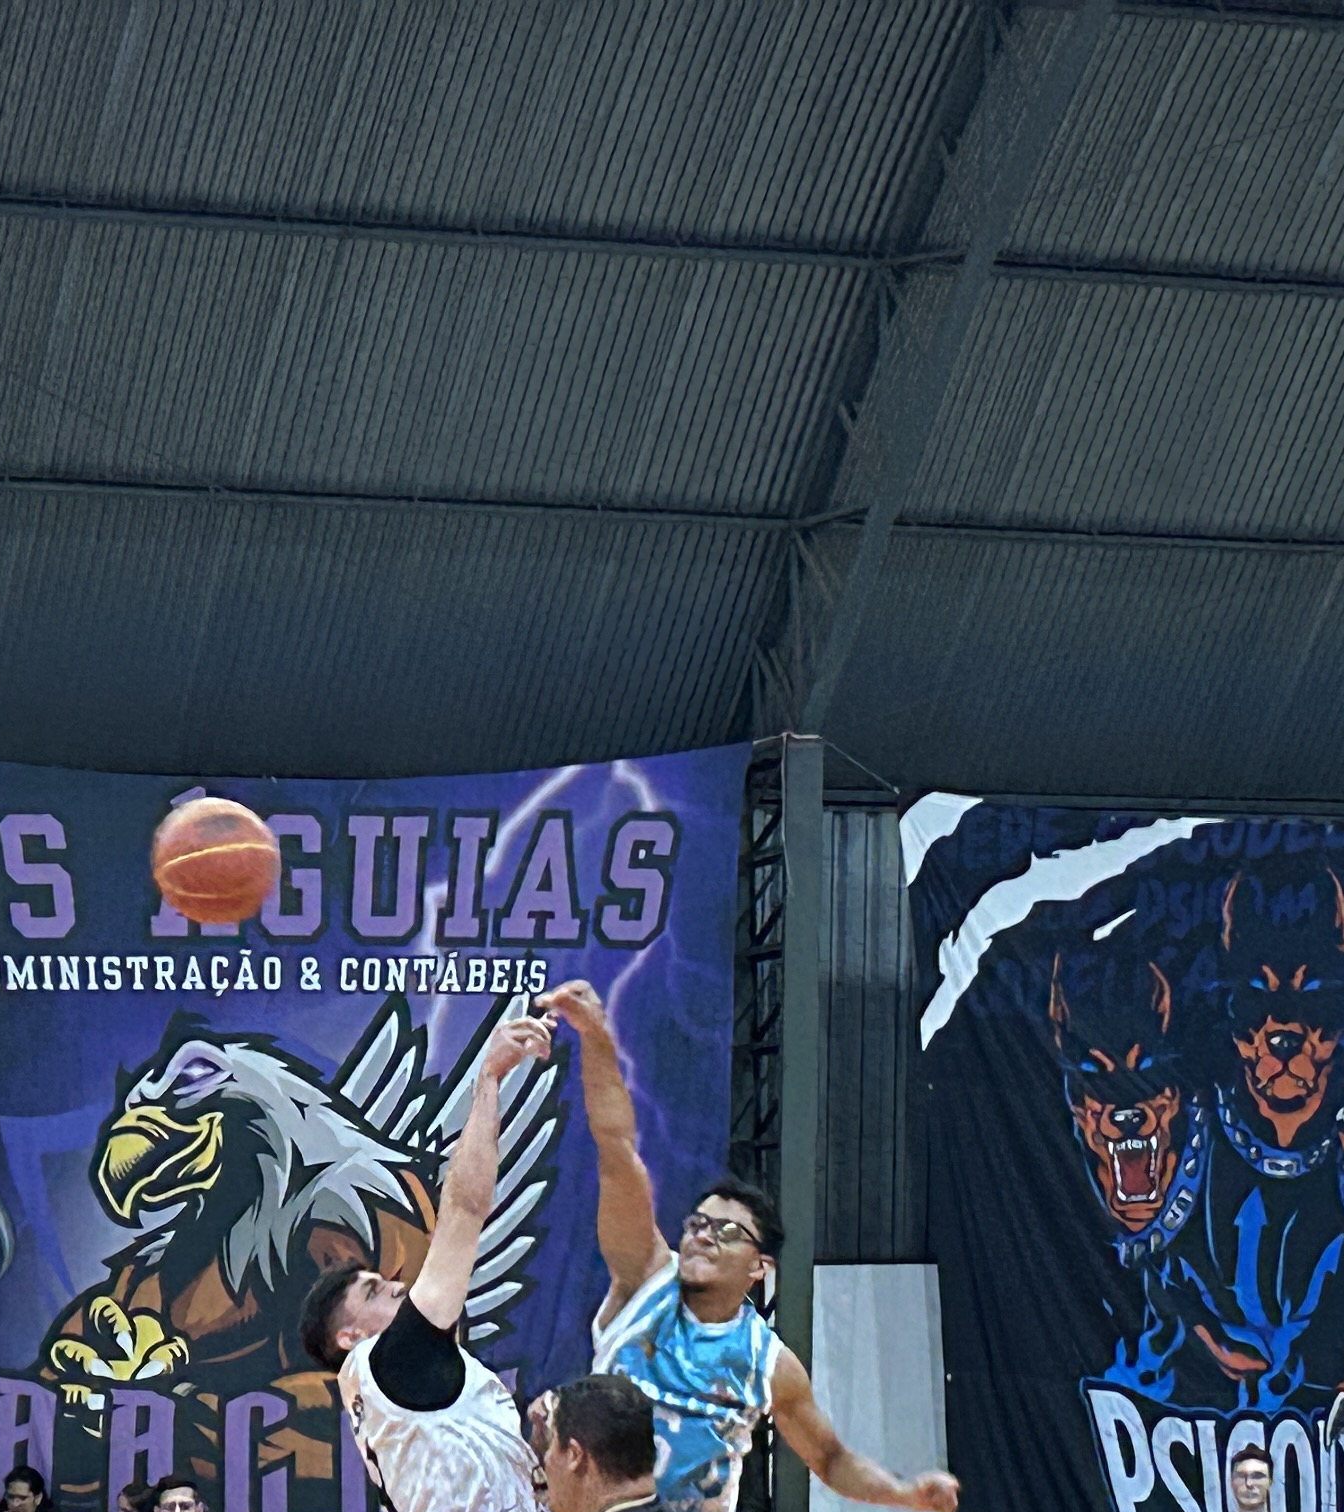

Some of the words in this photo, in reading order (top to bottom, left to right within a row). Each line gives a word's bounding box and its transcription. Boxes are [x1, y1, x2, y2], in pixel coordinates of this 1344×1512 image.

[150, 785, 674, 942] GUIAS
[300, 956, 322, 990] &
[340, 951, 547, 993] CONTÁBEIS
